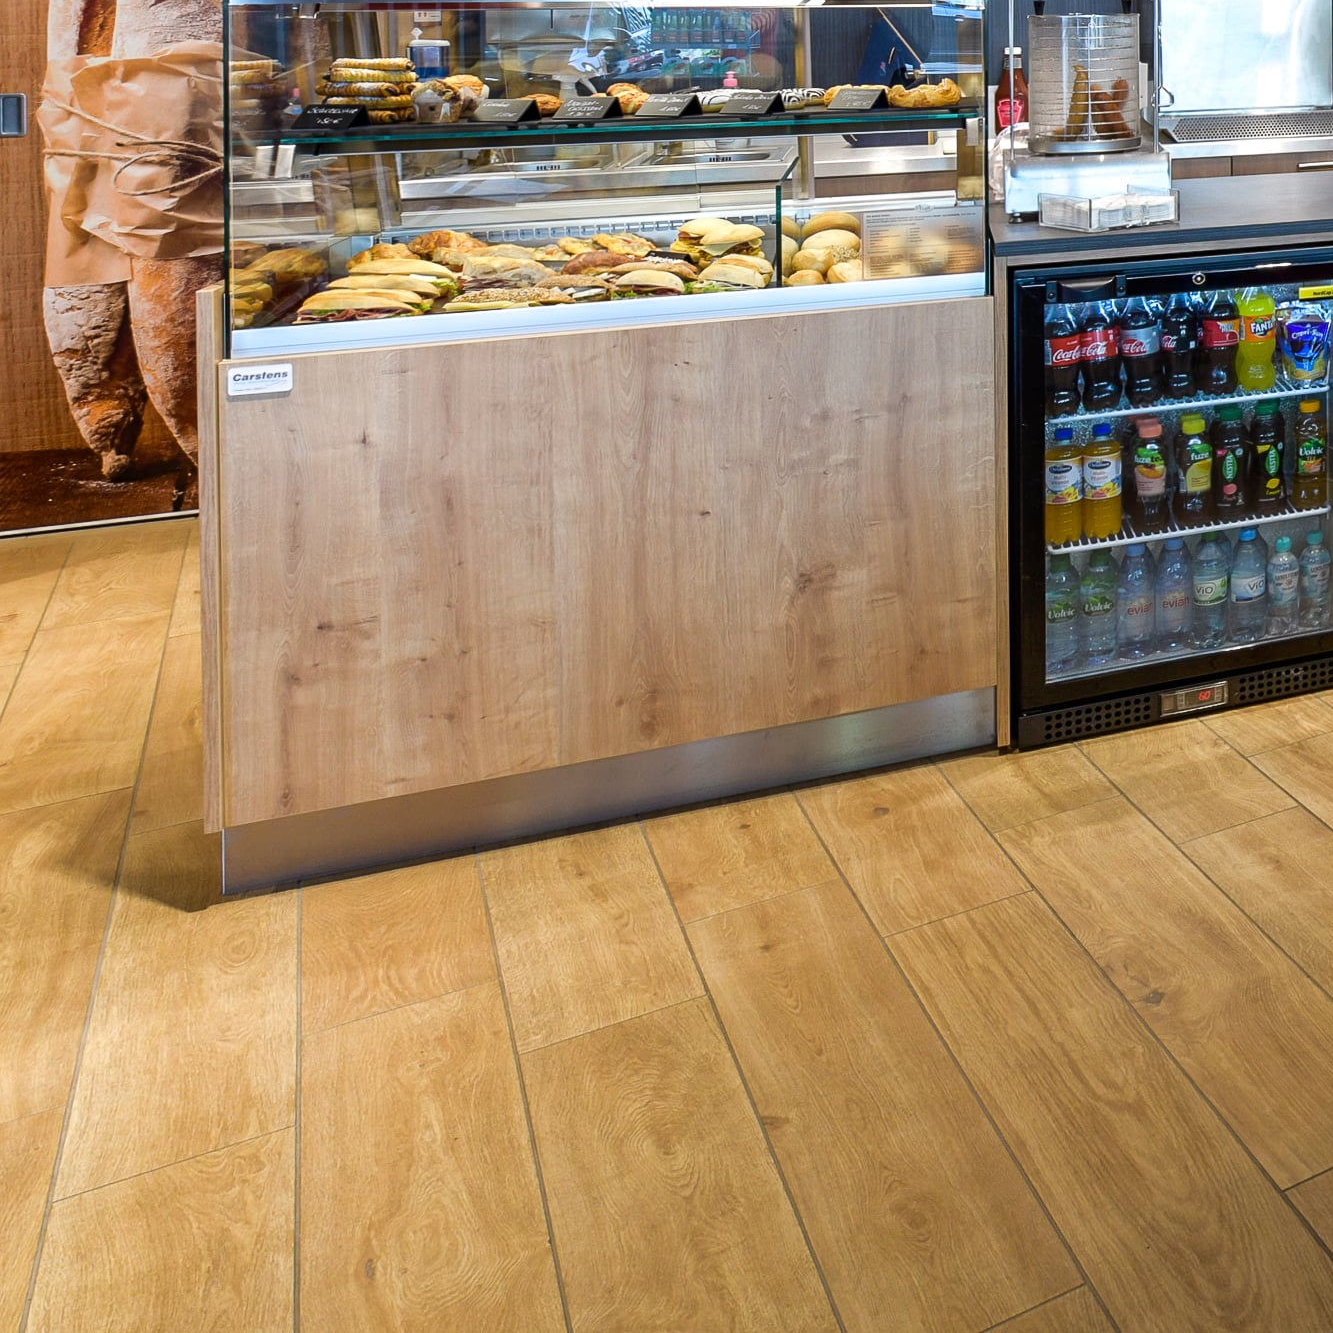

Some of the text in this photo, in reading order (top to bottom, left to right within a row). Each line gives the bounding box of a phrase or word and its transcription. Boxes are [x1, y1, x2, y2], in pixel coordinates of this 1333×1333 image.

[233, 371, 289, 382] Carstens
[1191, 452, 1209, 461] fuze
[1299, 447, 1324, 456] Volvic
[1085, 601, 1113, 612] Volvic
[1162, 597, 1189, 609] evian
[1048, 608, 1076, 619] Volvic
